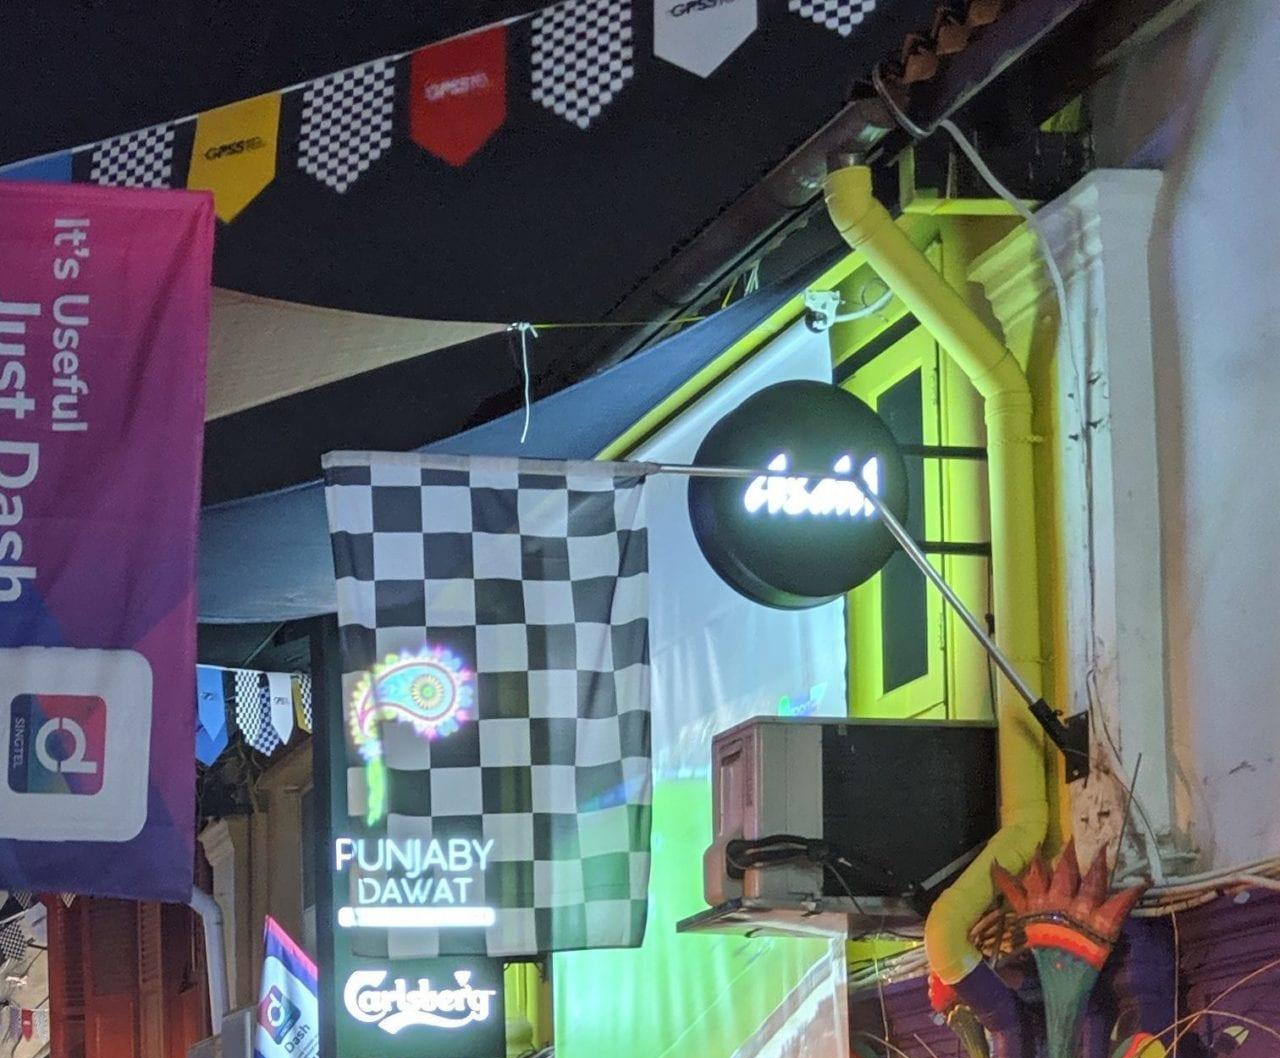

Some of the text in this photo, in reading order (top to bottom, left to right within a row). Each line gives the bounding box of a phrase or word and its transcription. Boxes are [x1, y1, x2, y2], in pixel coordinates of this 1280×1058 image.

[52, 217, 90, 432] It's Useful
[335, 838, 495, 878] PUNJABY
[357, 876, 473, 904] DAWAT
[343, 970, 497, 1034] Carlsberg
[284, 1023, 311, 1054] Dash
